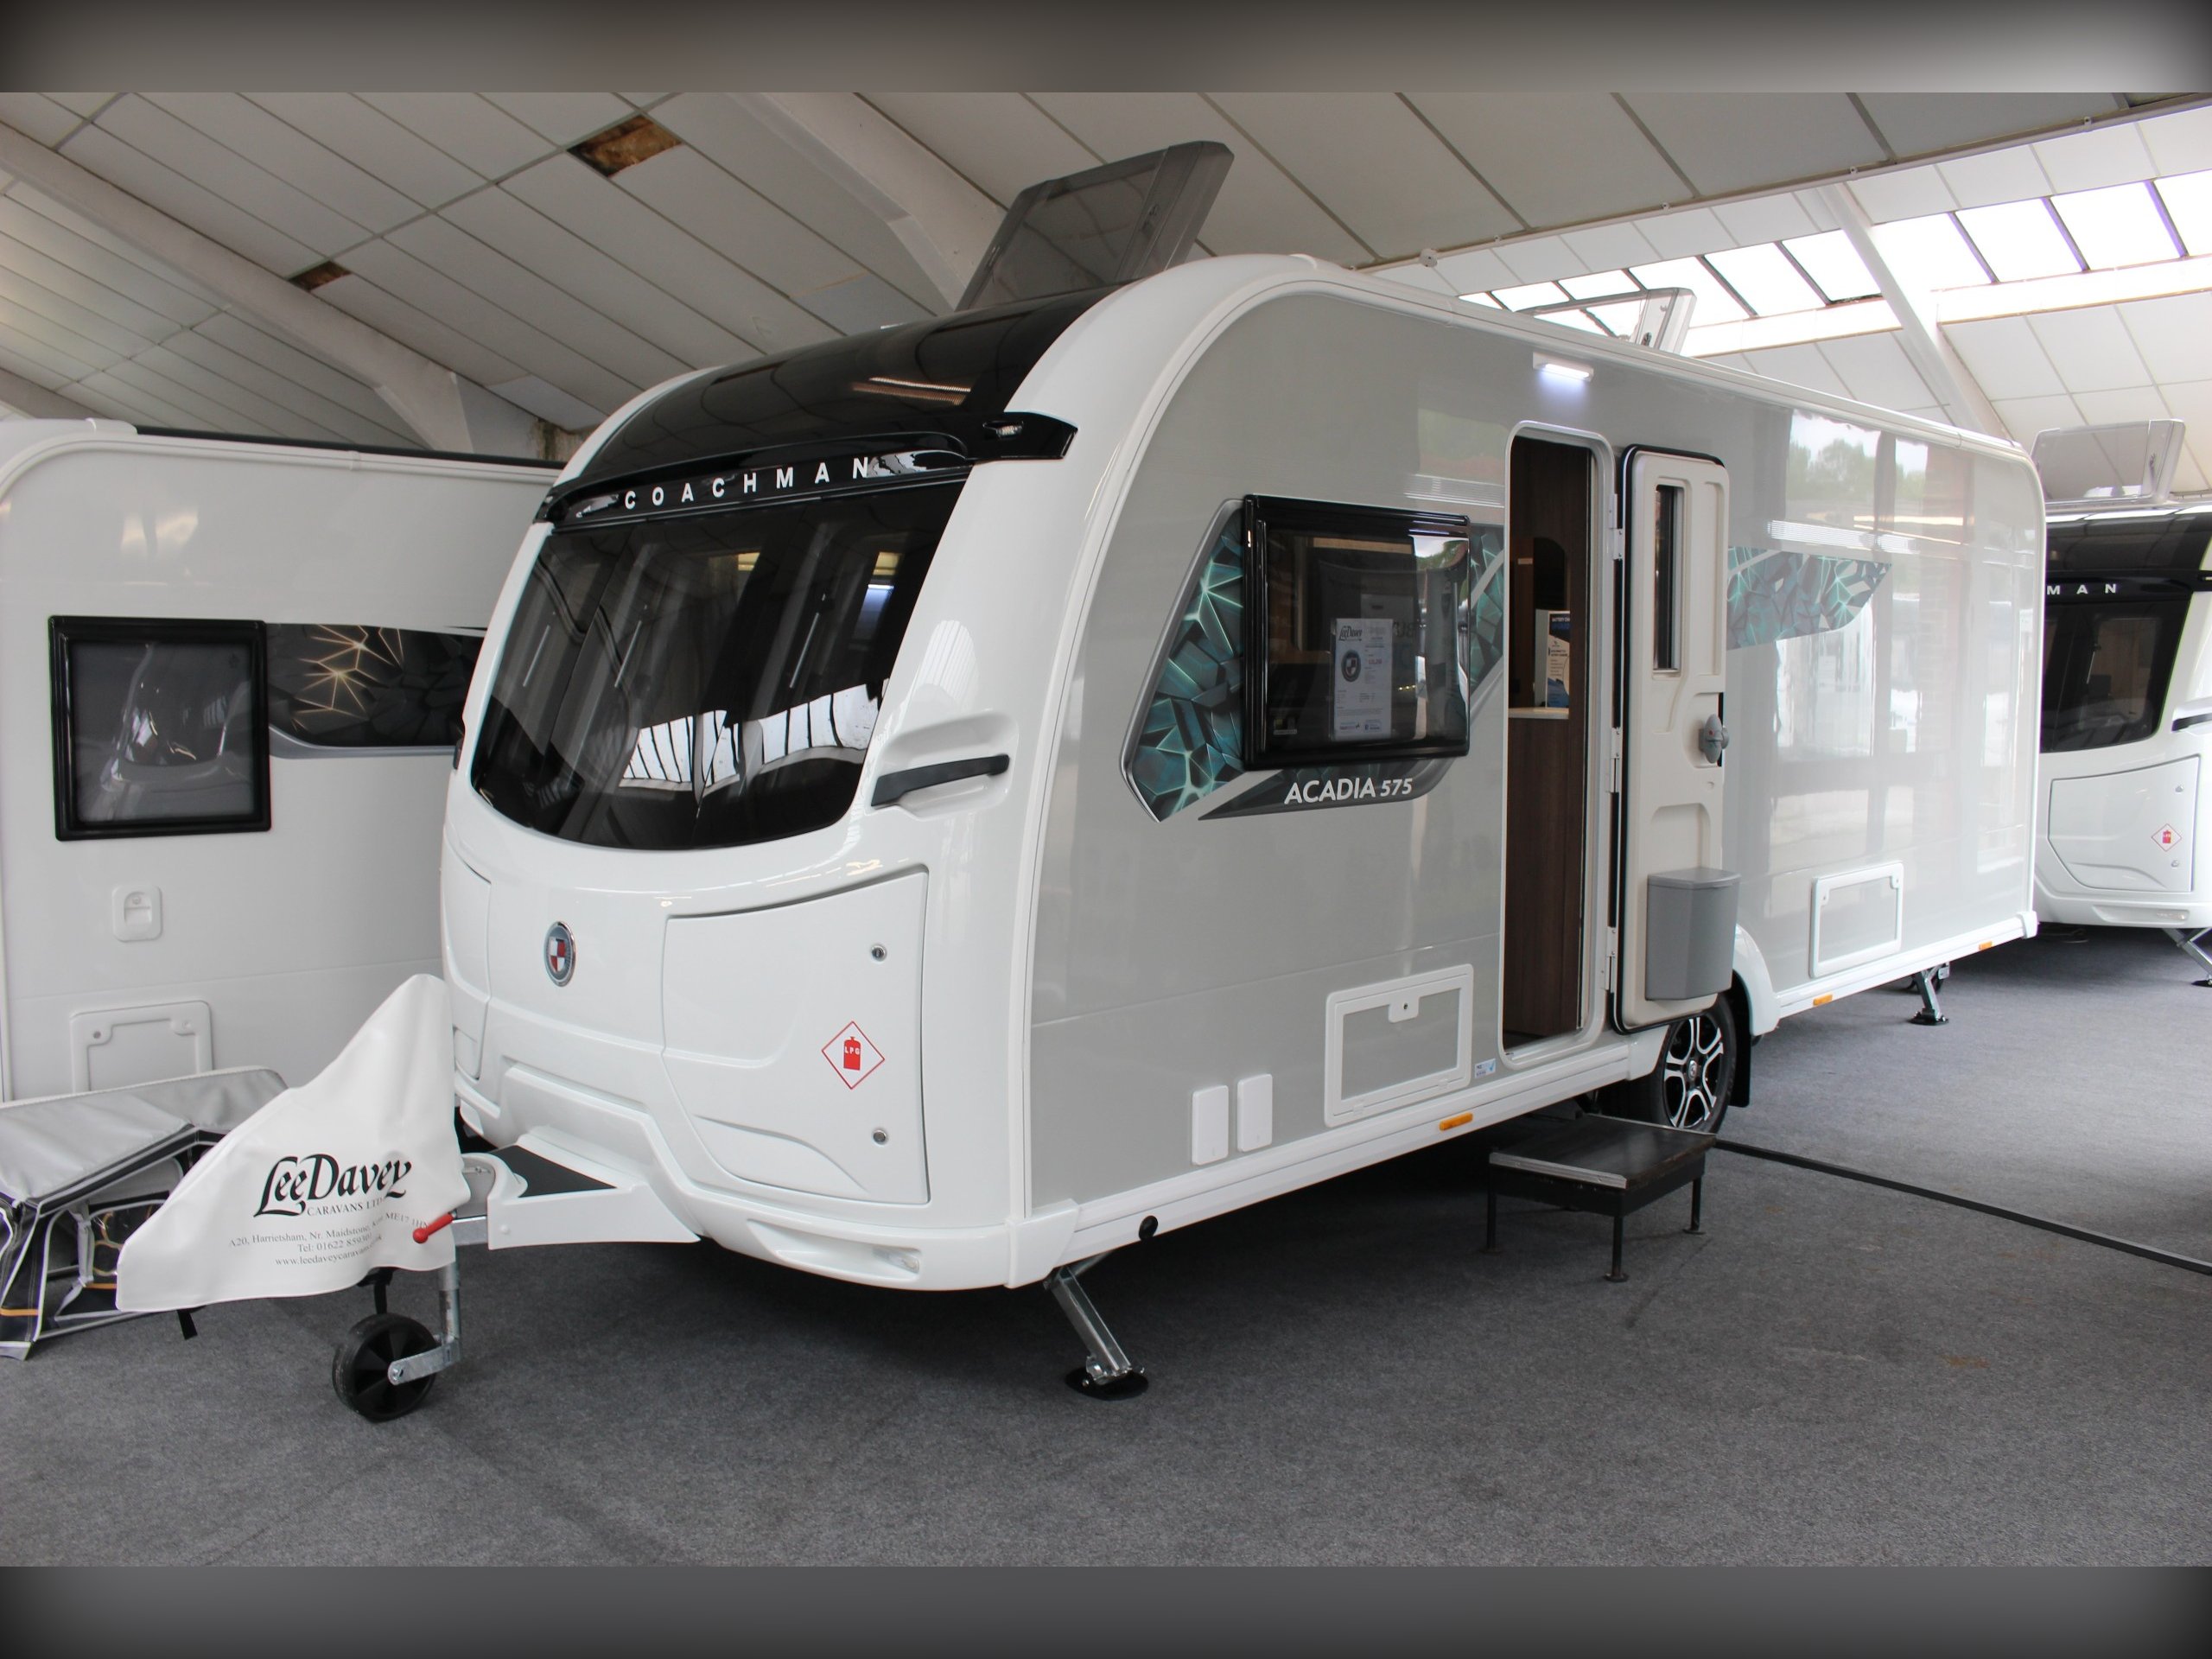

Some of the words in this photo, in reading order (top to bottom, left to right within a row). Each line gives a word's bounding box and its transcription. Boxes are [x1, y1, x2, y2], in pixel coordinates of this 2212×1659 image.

[624, 456, 868, 510] COACHMAN
[2046, 583, 2117, 595] MAN
[1284, 777, 1376, 804] ACADIA
[1380, 778, 1414, 798] 575
[844, 1046, 861, 1055] LPG
[307, 1202, 363, 1217] CARAVANS
[297, 1243, 315, 1253] Tel:
